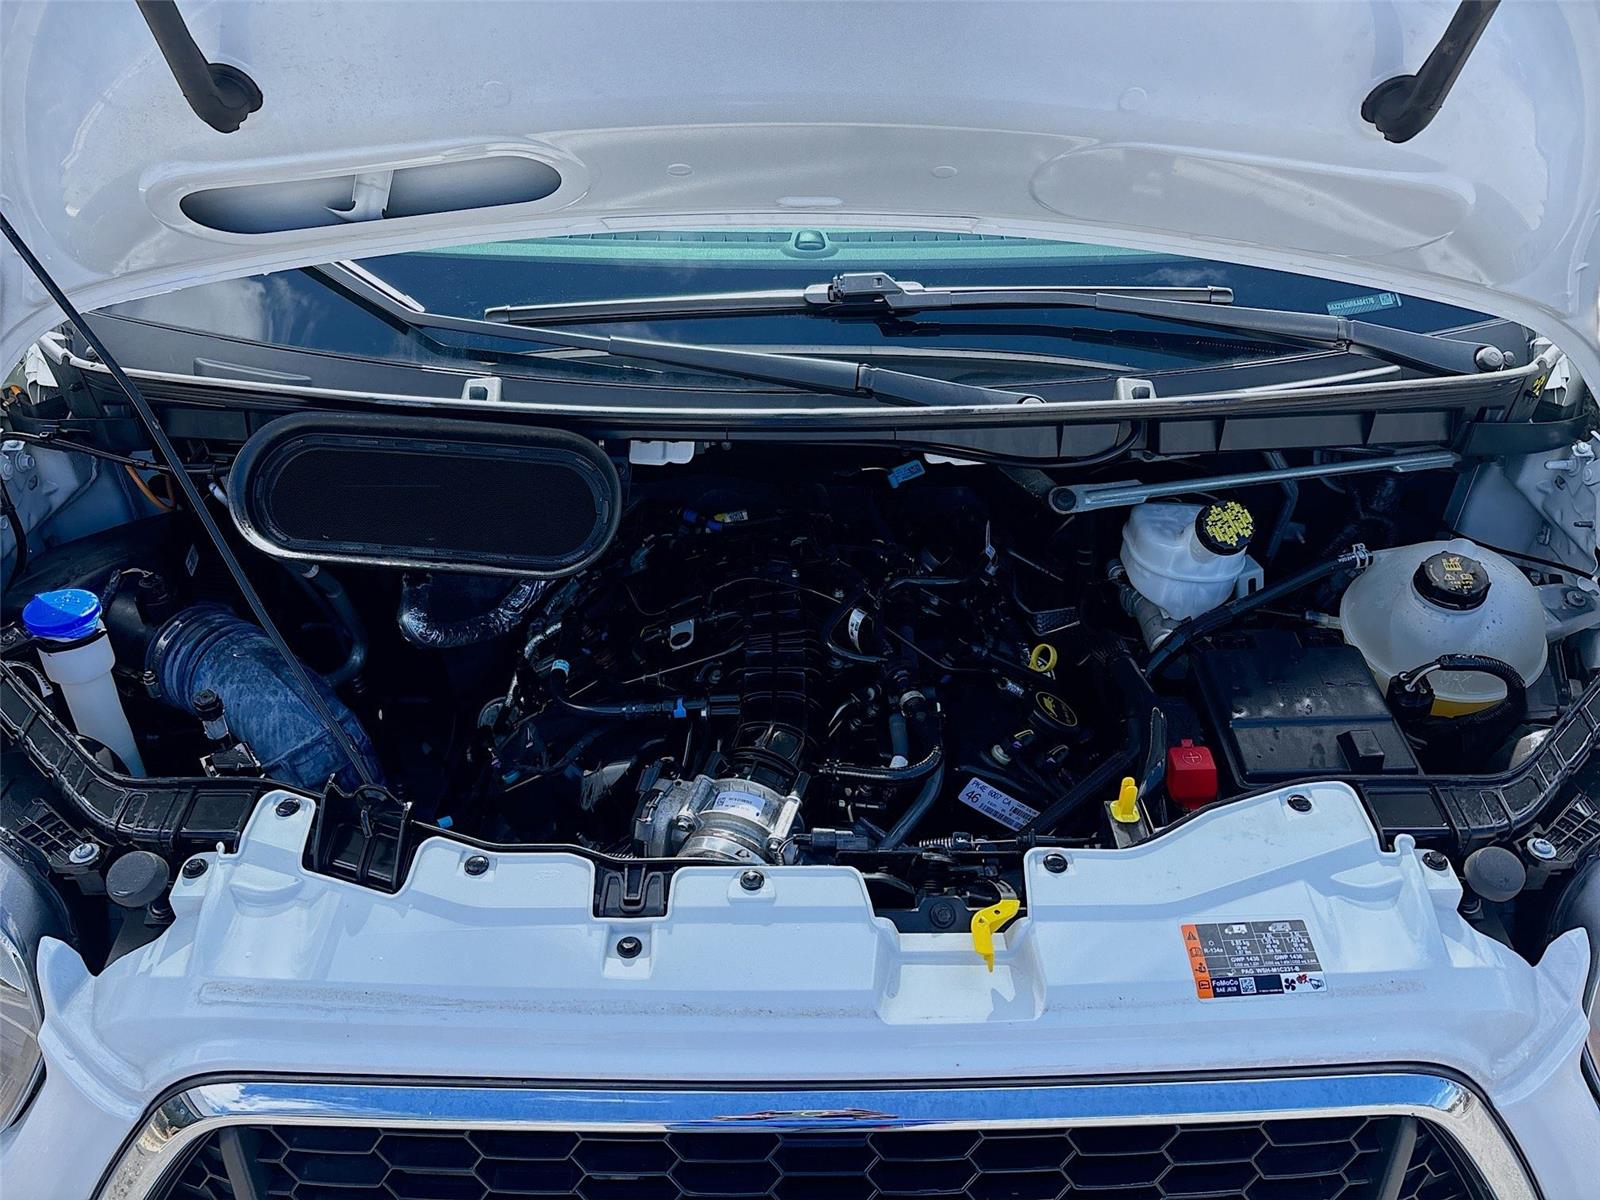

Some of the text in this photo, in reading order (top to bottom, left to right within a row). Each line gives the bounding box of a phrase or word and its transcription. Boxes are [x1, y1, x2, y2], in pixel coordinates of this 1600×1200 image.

[966, 790, 982, 804] 46
[971, 780, 988, 793] PK4E
[1002, 797, 1012, 807] CA
[1211, 979, 1239, 987] FoMoCo
